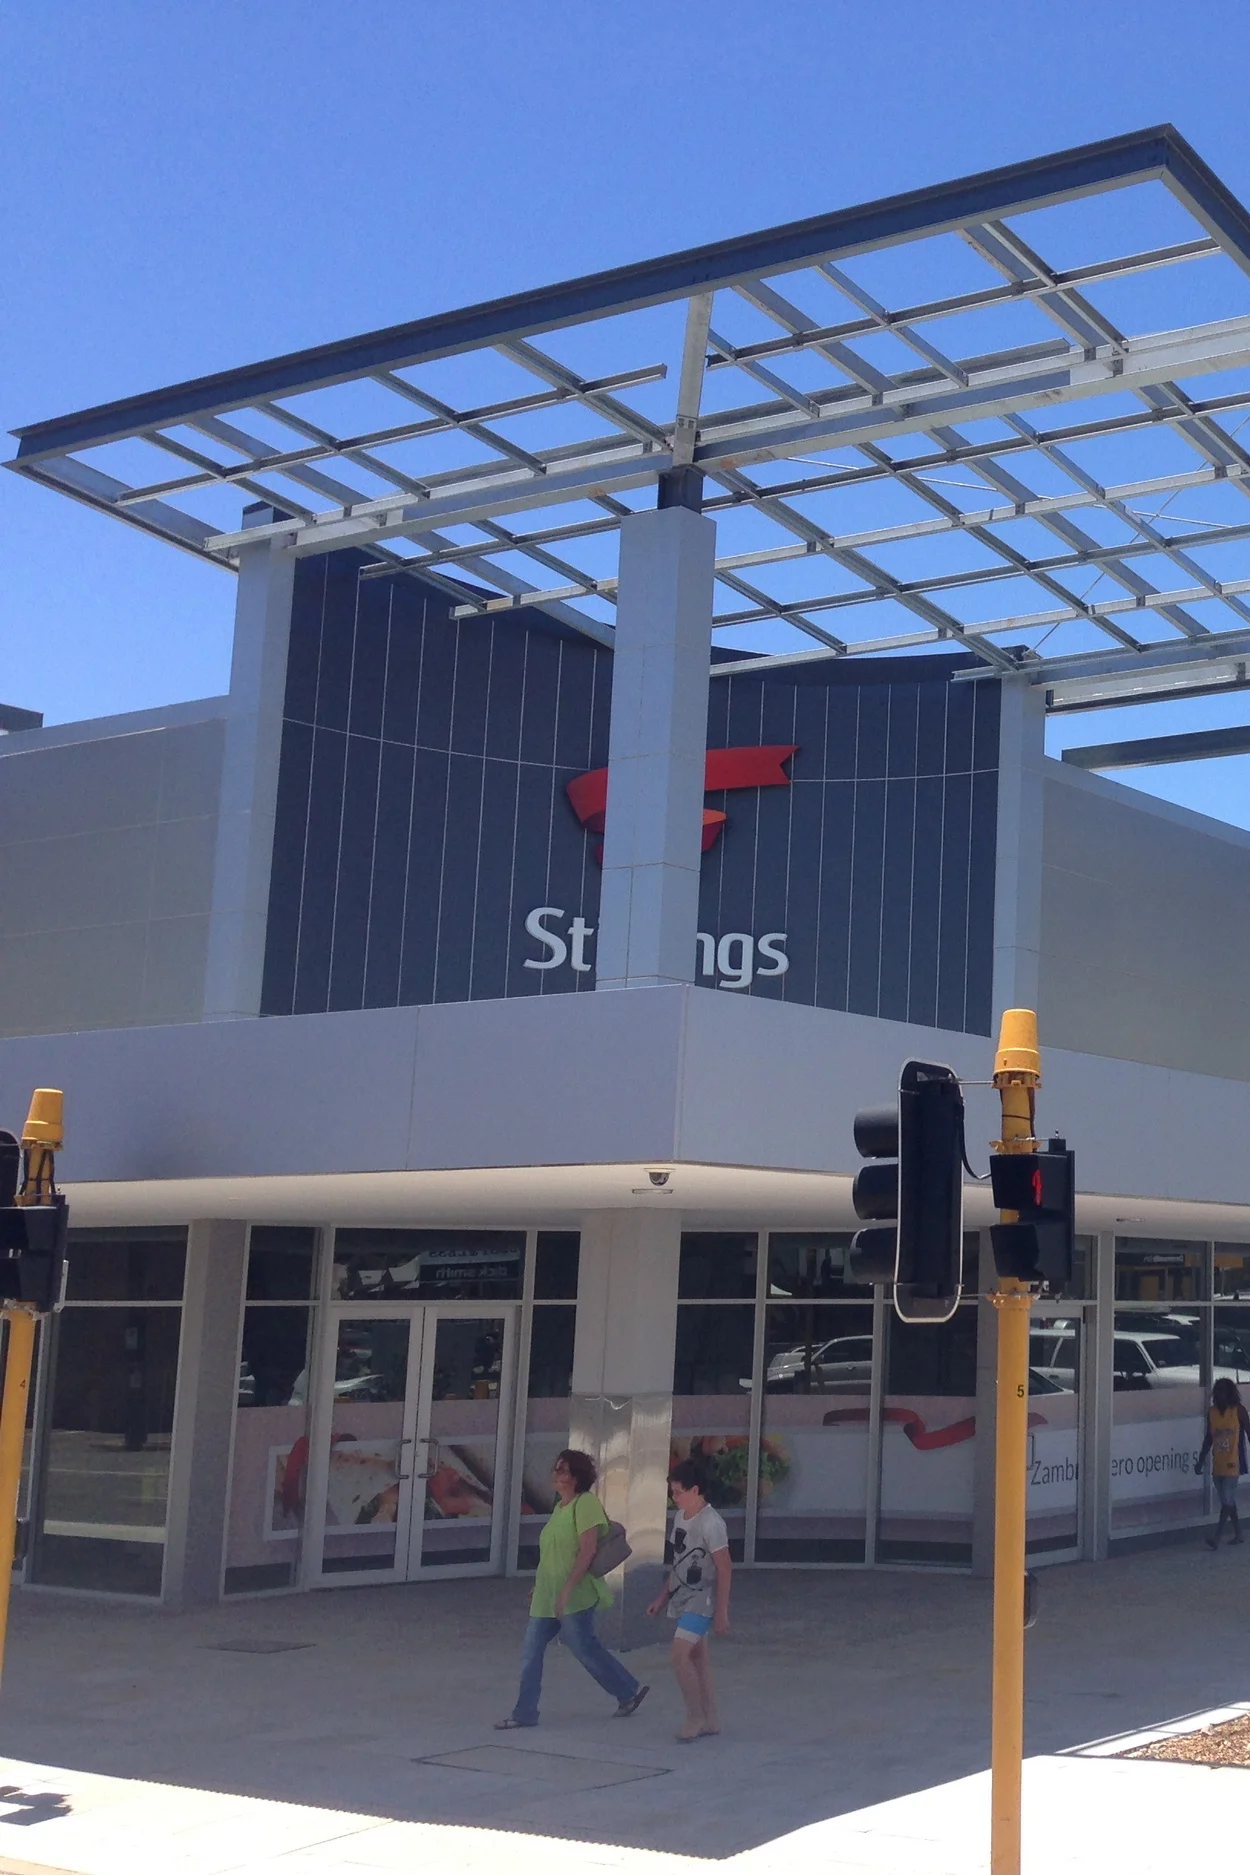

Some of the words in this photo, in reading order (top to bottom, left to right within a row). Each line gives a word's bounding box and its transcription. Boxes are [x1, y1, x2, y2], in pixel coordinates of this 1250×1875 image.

[523, 907, 789, 988] Stngs
[1016, 1384, 1025, 1398] 5
[1137, 1447, 1190, 1477] opening
